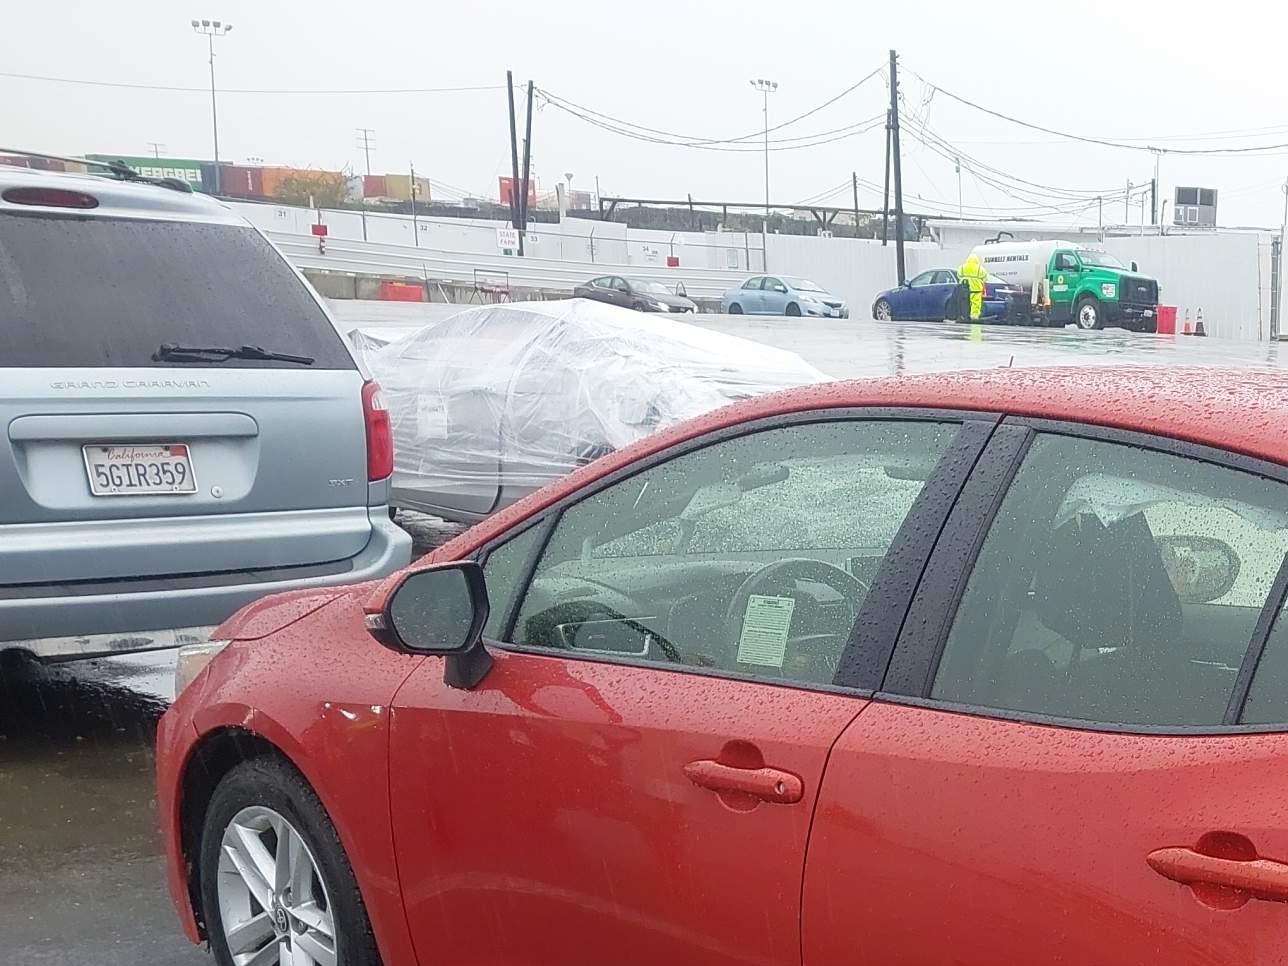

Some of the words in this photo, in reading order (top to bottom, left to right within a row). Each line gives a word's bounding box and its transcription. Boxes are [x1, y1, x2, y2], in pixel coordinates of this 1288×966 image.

[50, 381, 118, 390] GRAND
[122, 379, 211, 389] CARAVAN
[106, 447, 168, 462] California
[94, 462, 187, 488] 5GIR359
